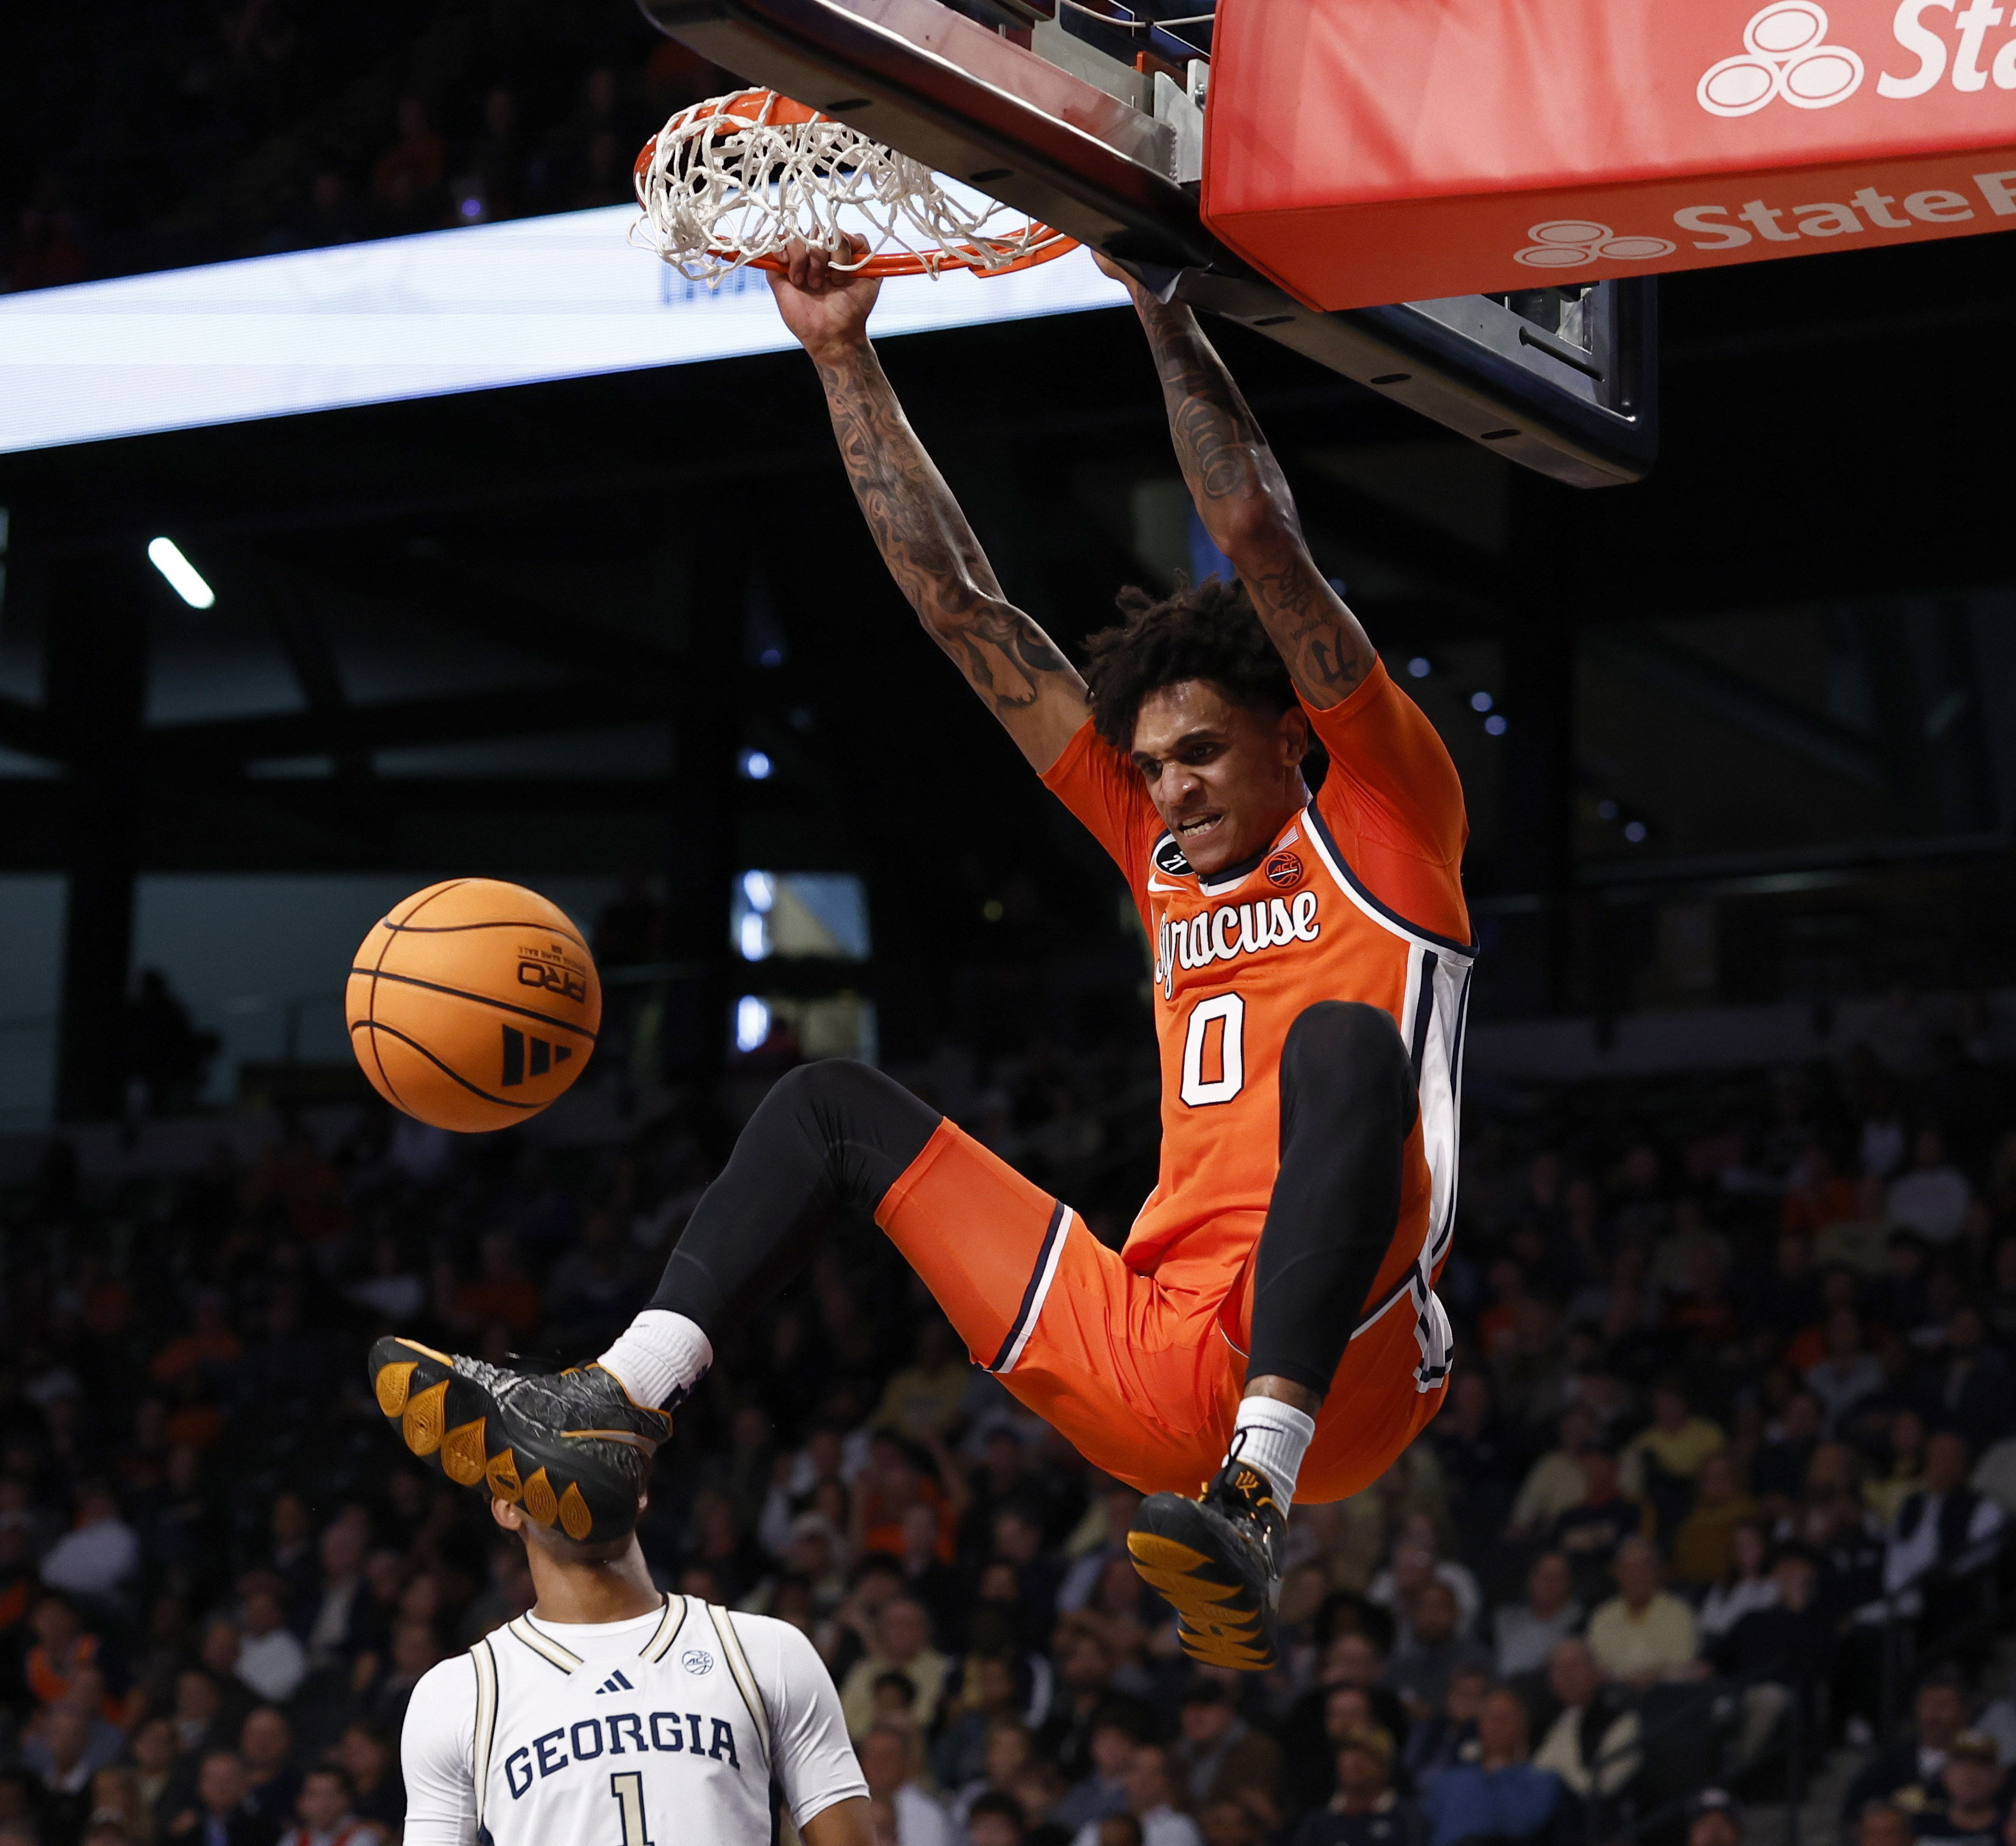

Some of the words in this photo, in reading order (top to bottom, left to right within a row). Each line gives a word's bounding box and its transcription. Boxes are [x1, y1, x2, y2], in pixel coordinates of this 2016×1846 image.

[1673, 186, 1975, 250] State
[1271, 860, 1298, 874] ACC
[518, 962, 586, 1004] PRO
[1179, 991, 1246, 1109] 0
[505, 1711, 741, 1801] GEORGIA
[610, 1770, 655, 1846] 1
